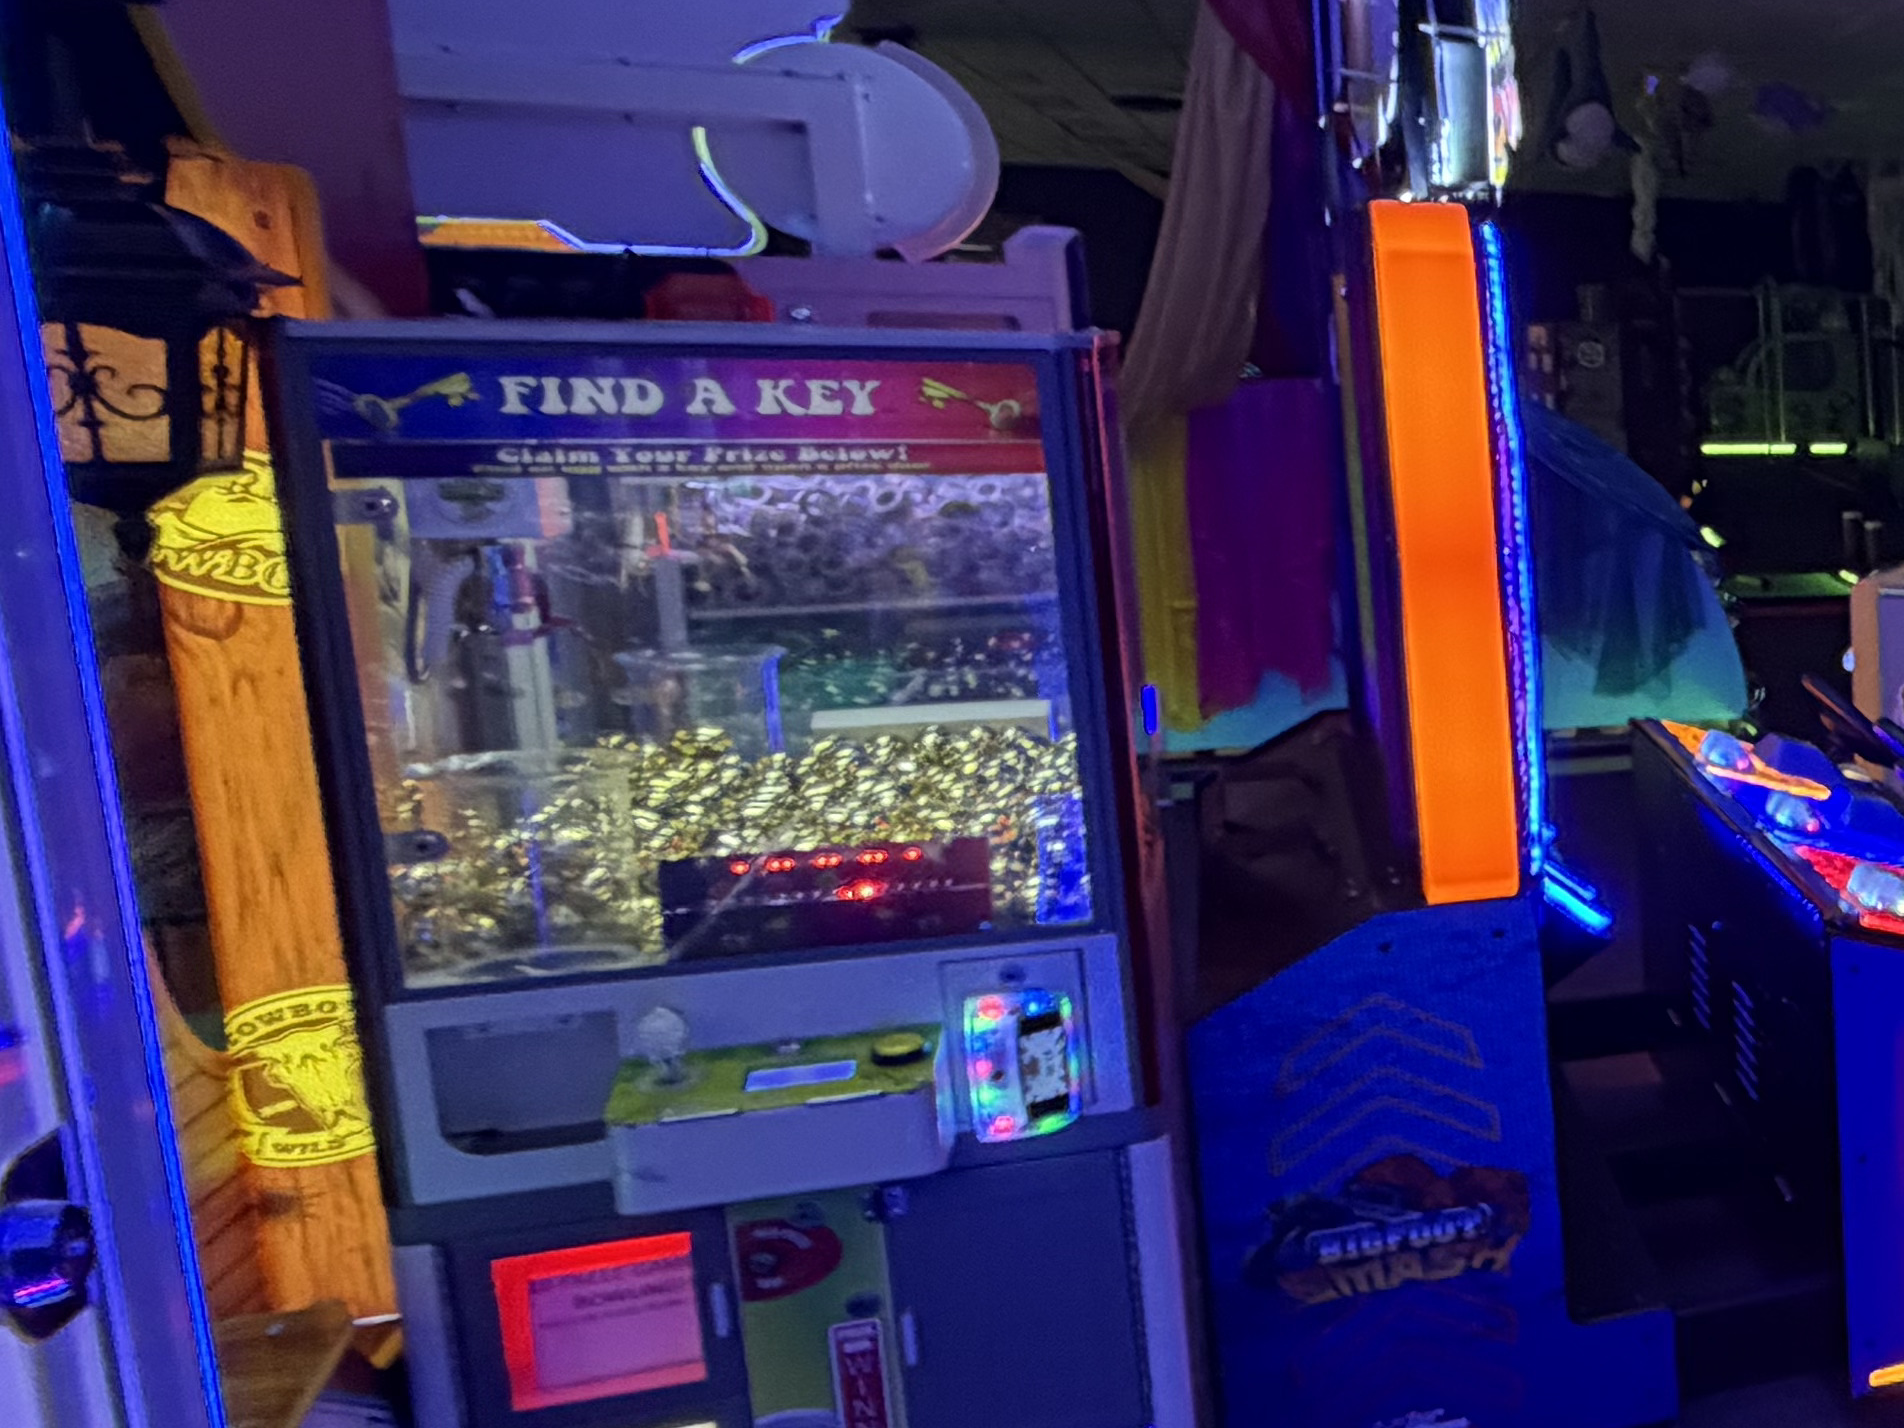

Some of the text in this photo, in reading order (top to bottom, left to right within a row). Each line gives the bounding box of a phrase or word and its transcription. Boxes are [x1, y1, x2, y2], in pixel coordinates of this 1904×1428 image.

[498, 375, 882, 417] FIND A KEY
[496, 447, 600, 464] Claim
[608, 447, 692, 464] Your
[227, 998, 353, 1049] OWBO
